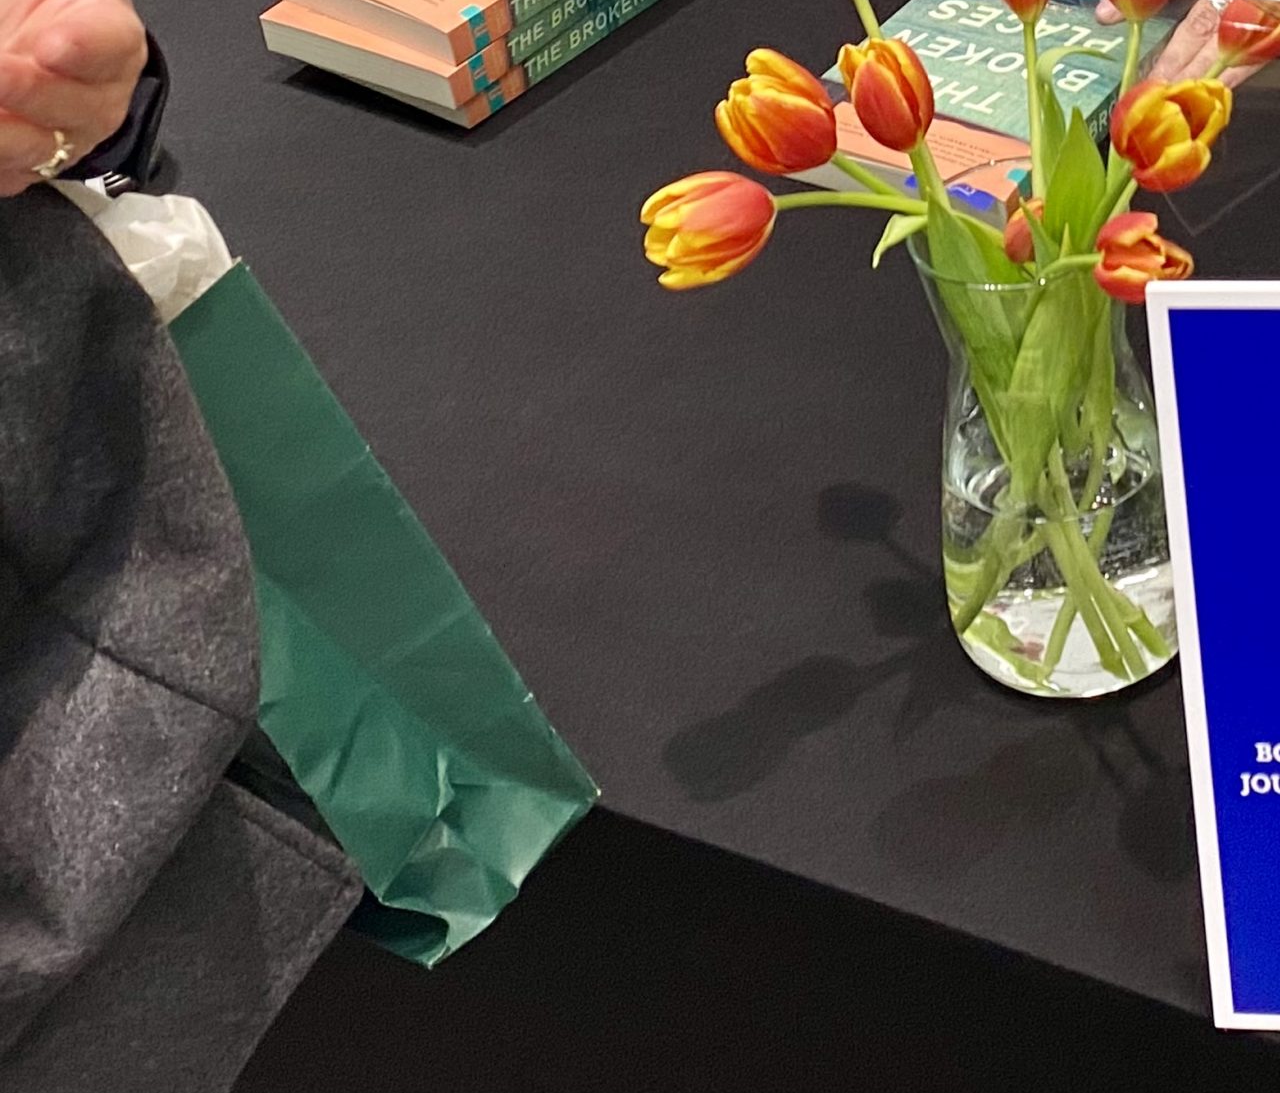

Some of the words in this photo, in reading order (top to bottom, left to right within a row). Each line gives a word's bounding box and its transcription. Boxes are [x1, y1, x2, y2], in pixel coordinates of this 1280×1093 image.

[507, 18, 545, 58] THE
[524, 40, 562, 79] THE
[930, 73, 1004, 116] TH
